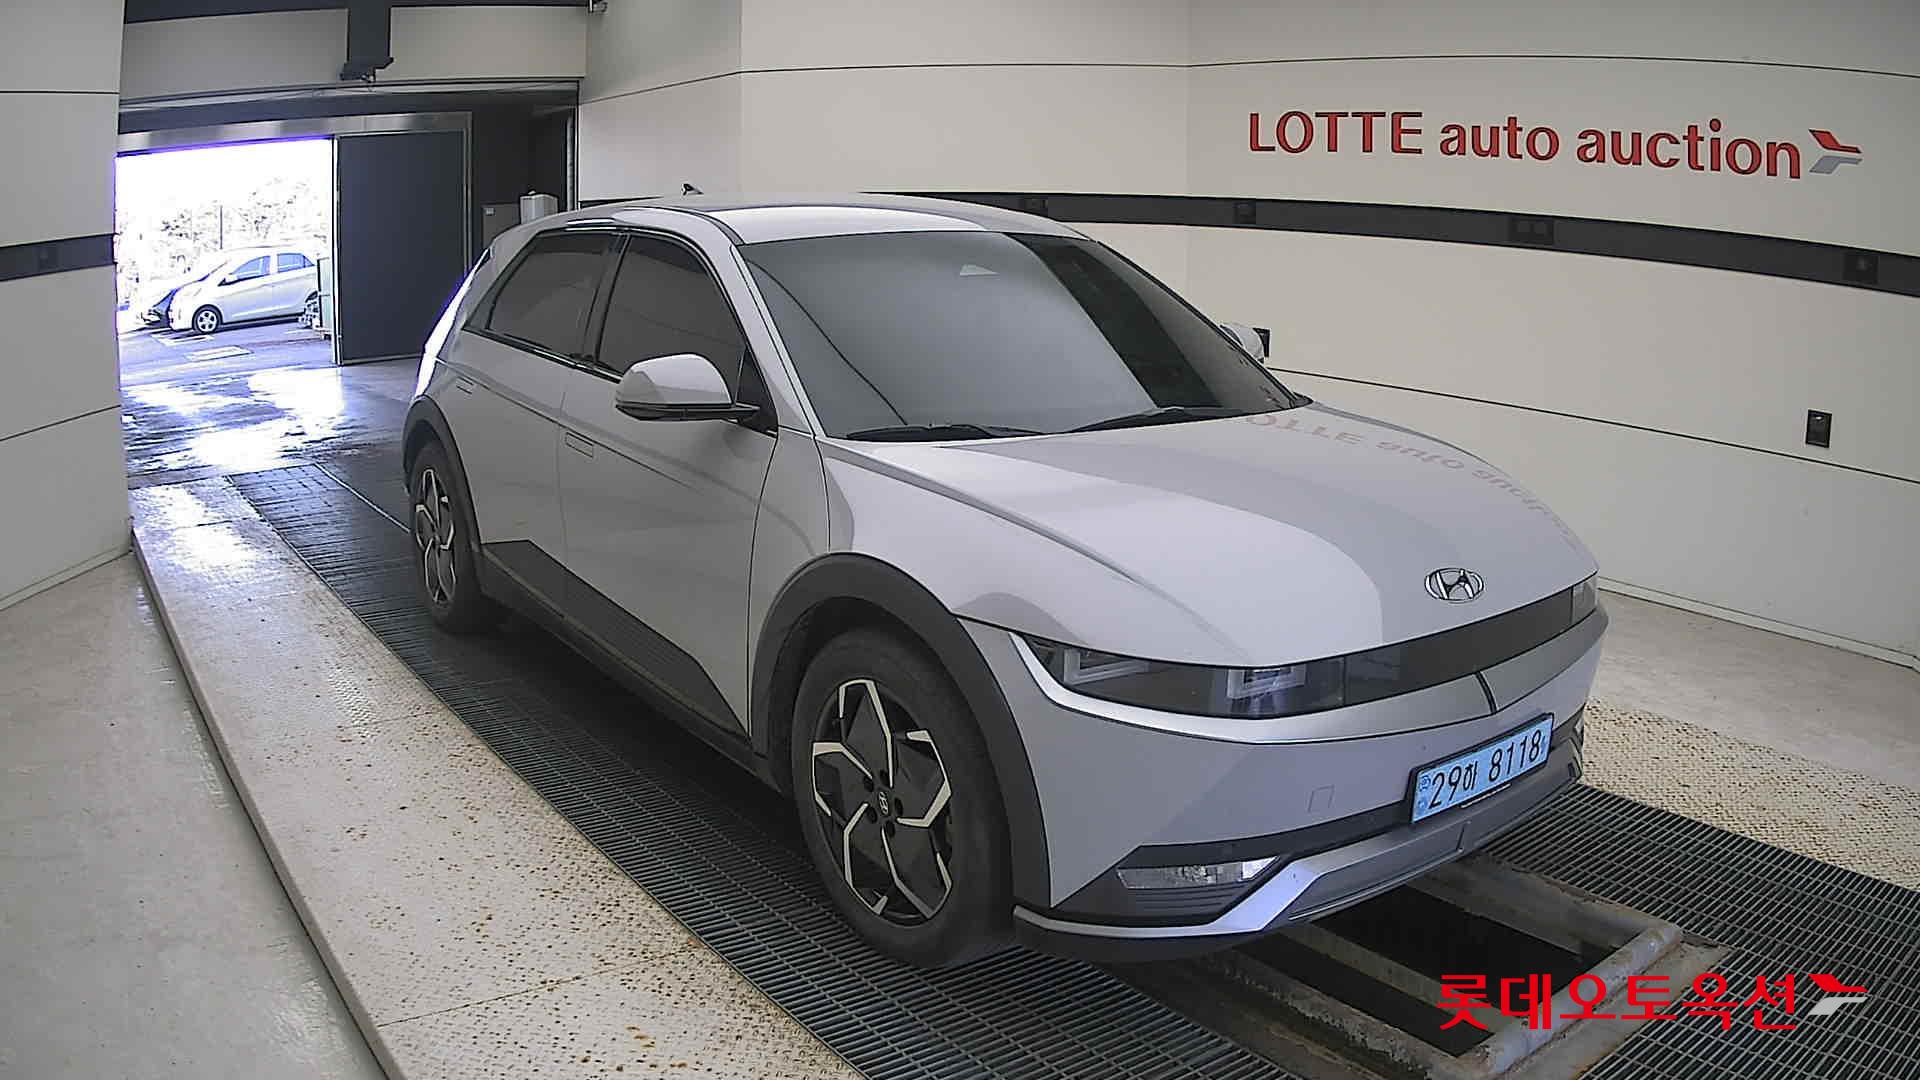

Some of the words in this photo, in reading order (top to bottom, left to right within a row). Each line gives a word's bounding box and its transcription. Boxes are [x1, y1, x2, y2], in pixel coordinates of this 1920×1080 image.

[1249, 111, 1423, 155] LOTTE
[1440, 116, 1560, 161] auto
[1576, 119, 1801, 179] auction
[1428, 760, 1479, 810] 29하
[1488, 729, 1542, 782] 8118
